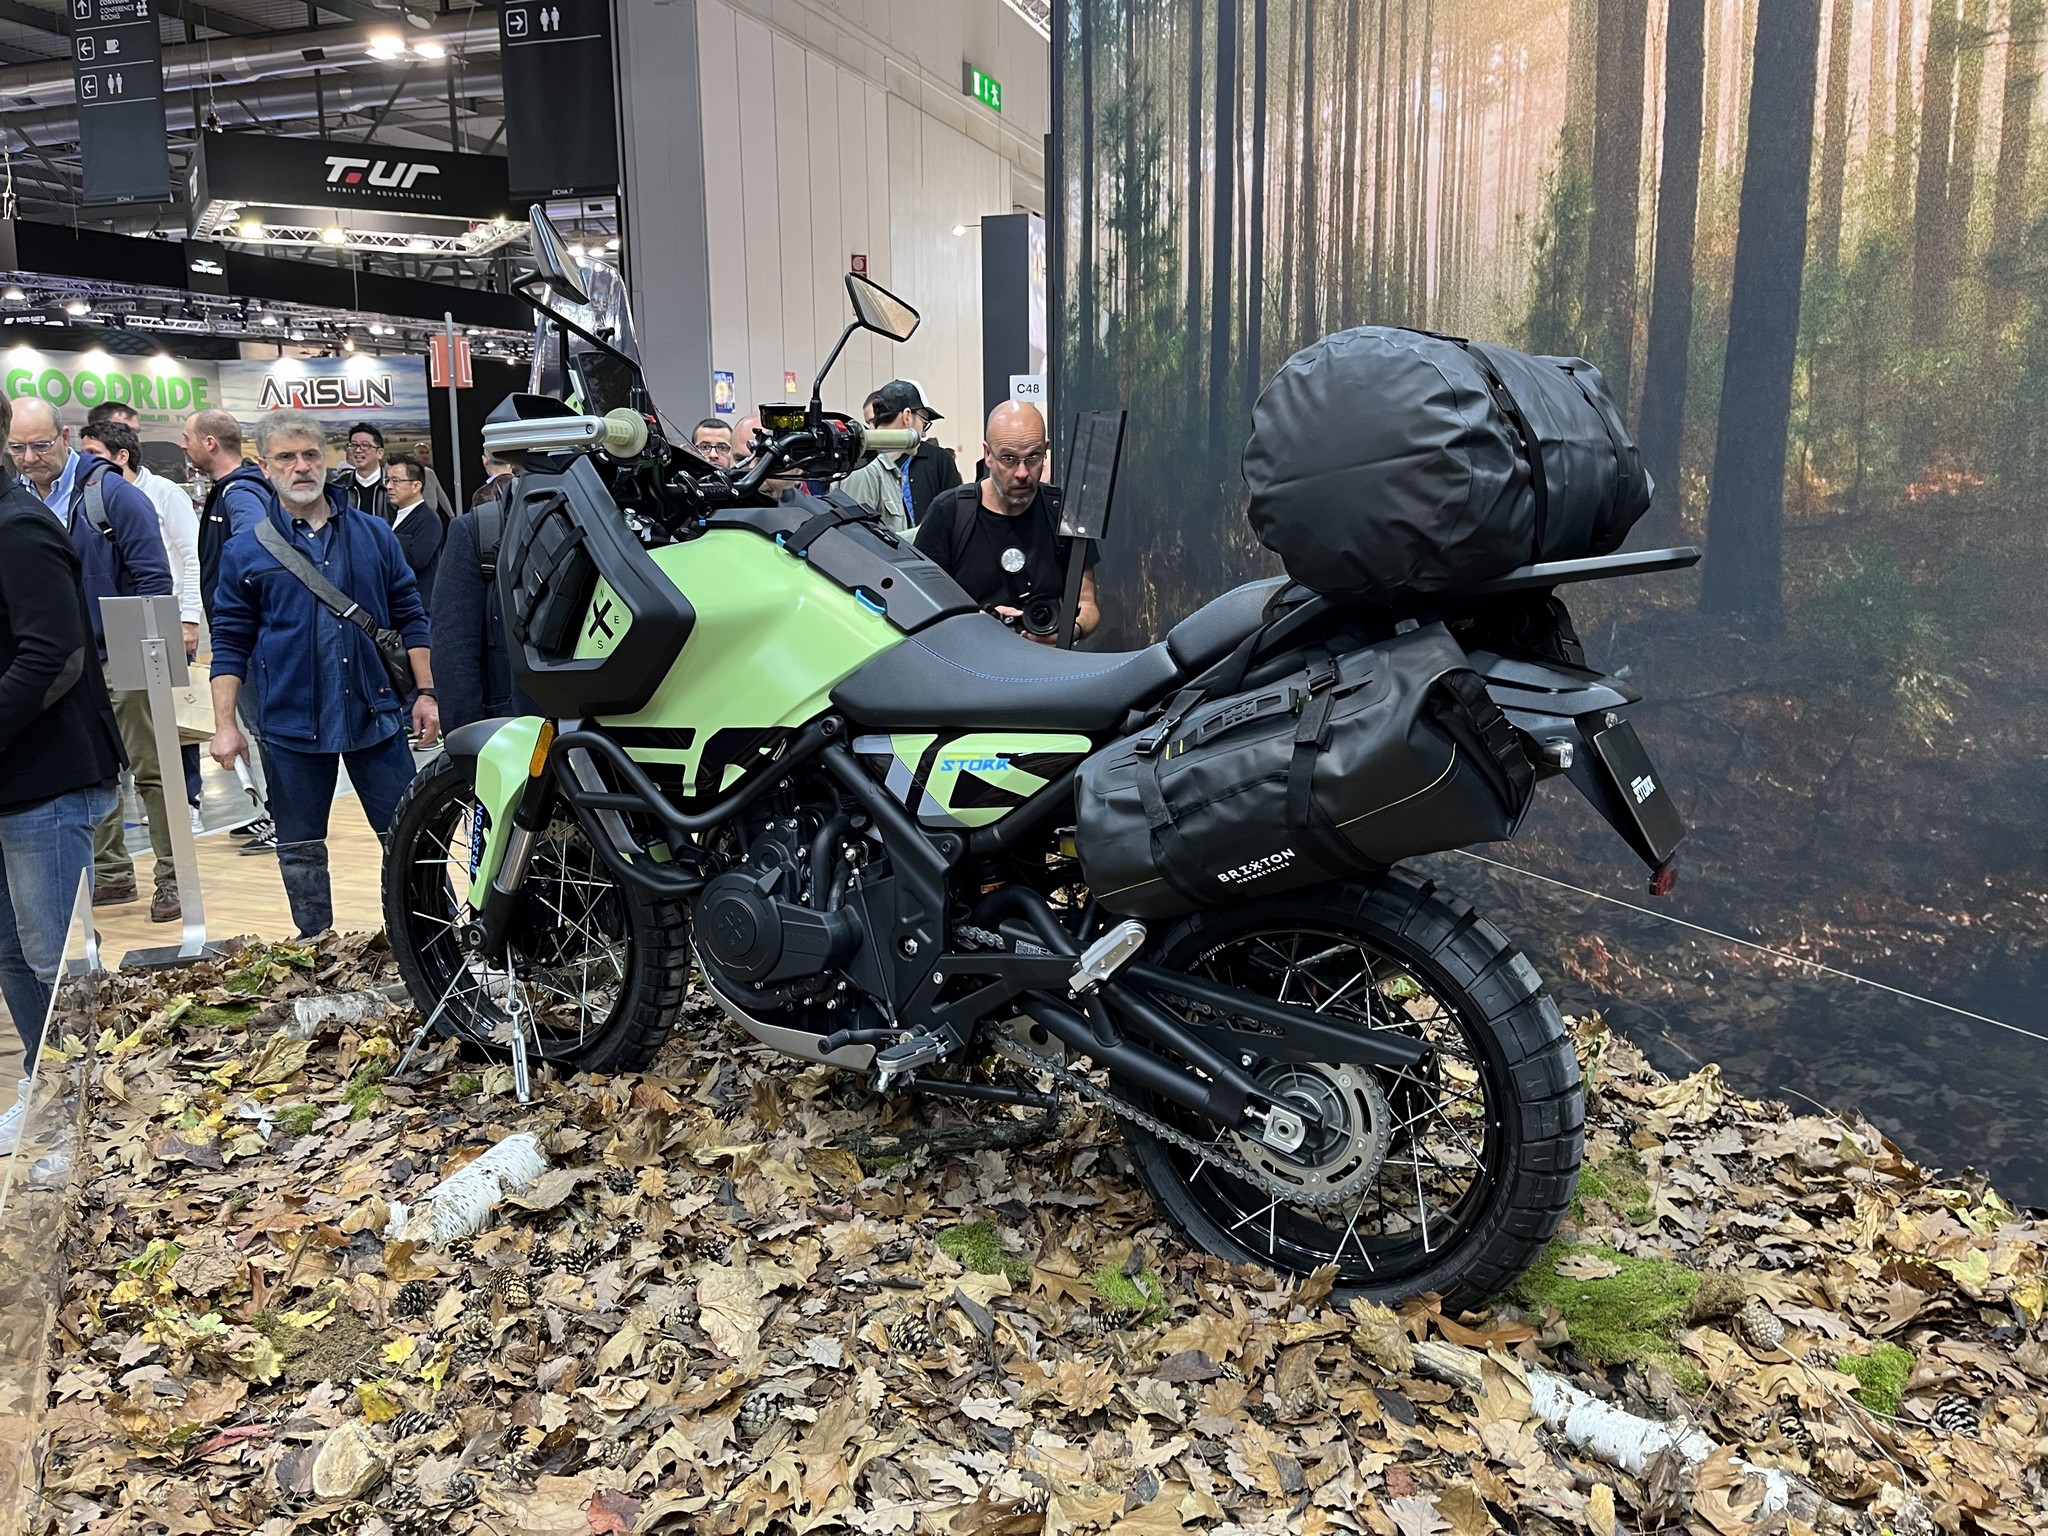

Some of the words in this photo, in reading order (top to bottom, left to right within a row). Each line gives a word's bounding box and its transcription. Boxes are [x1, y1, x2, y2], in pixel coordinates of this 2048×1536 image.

[100, 4, 135, 14] CONFERENCE
[100, 13, 121, 21] ROOMS
[326, 186, 356, 194] SPIRIT
[6, 368, 212, 410] GOODRIDE
[257, 375, 394, 409] ARISUN
[1017, 383, 1040, 394] C48
[613, 615, 620, 625] E
[597, 640, 604, 650] S
[465, 803, 484, 874] BRIXTON
[1217, 848, 1296, 883] BRIXTON
[1236, 861, 1290, 884] MOTORCYCLES
